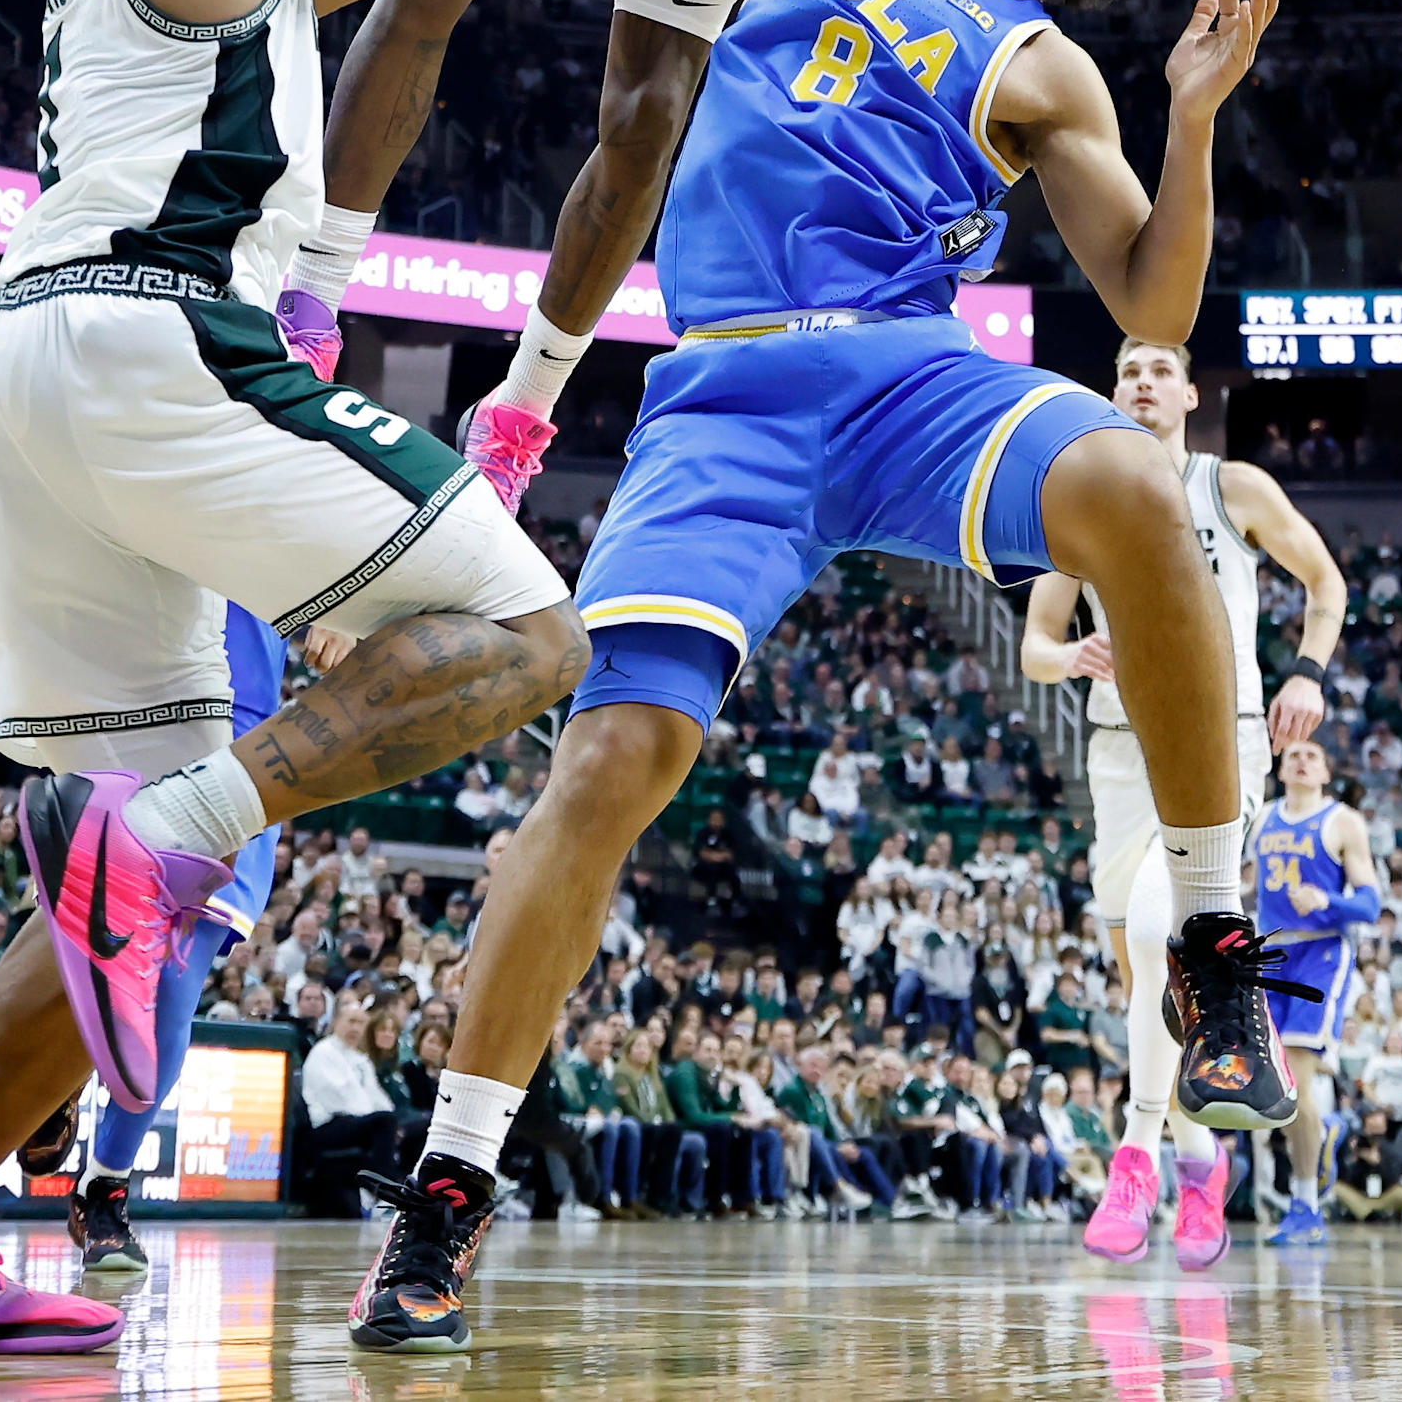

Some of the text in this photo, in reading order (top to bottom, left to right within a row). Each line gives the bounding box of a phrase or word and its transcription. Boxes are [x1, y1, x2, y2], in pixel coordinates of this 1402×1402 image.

[789, 15, 875, 107] 8
[392, 254, 509, 312] Hiring
[323, 390, 411, 446] S
[1259, 831, 1316, 860] UCLA
[1264, 856, 1302, 892] 34
